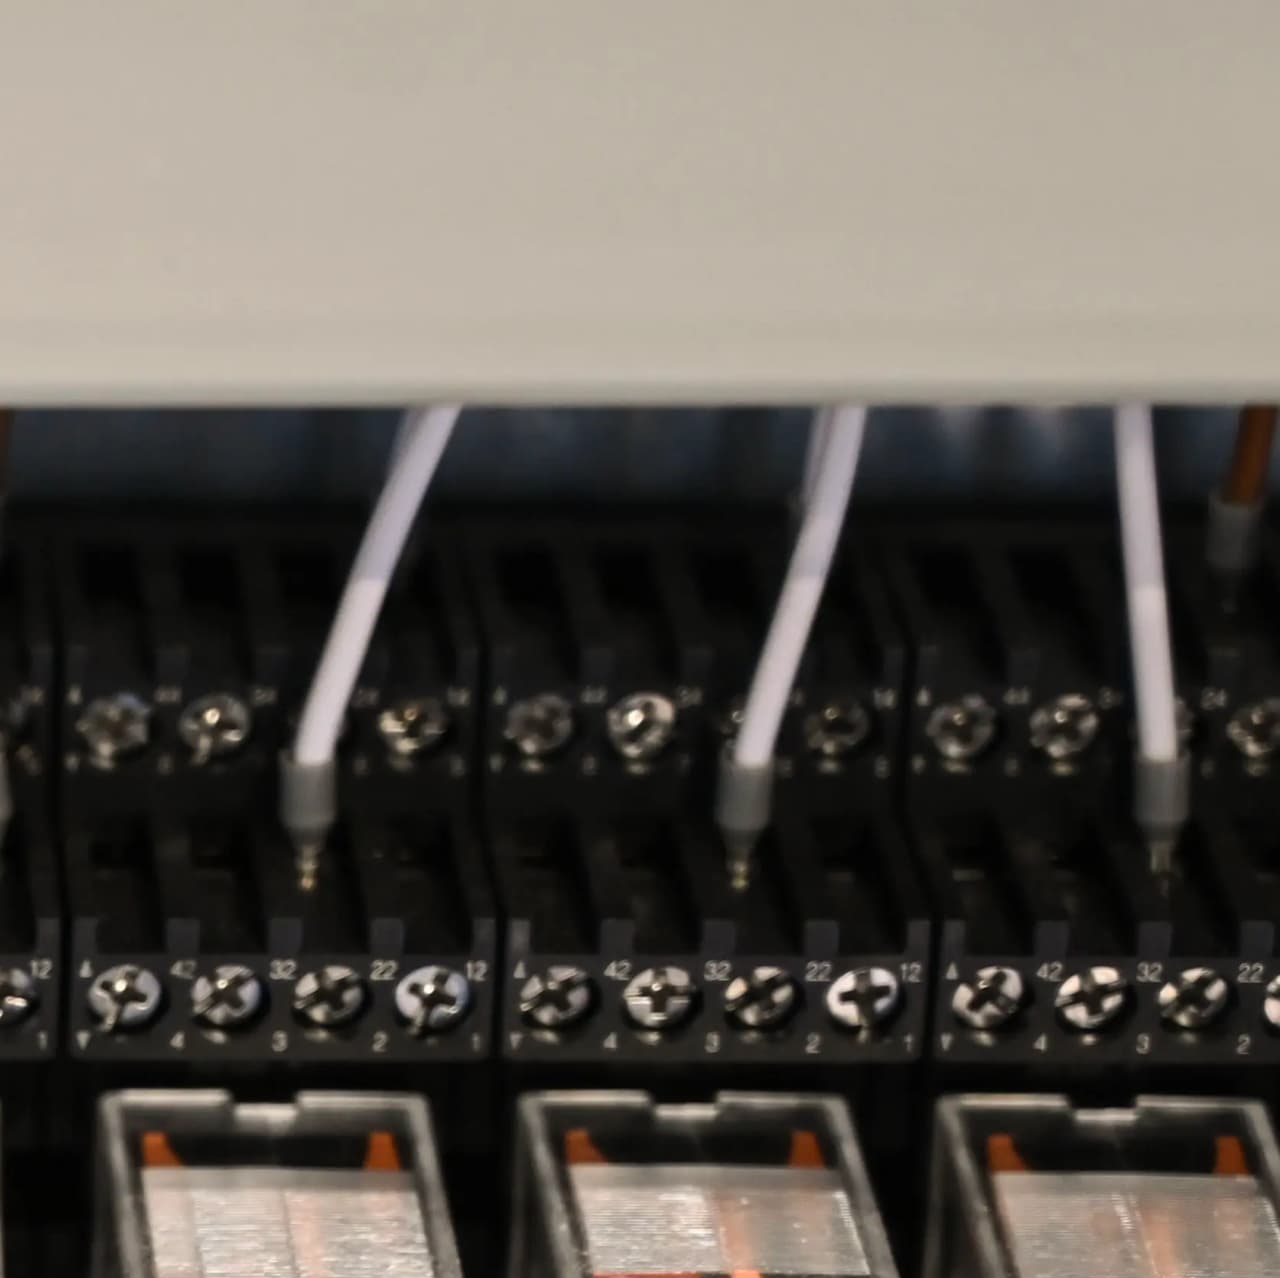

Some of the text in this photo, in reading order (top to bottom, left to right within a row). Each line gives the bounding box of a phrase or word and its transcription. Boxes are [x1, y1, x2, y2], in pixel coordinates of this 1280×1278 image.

[31, 960, 51, 979] 12
[171, 960, 487, 981] 42 32 22 12
[604, 960, 921, 982] 42 32 22 12
[1037, 962, 1264, 983] 42 32 22
[171, 1032, 184, 1048] 4
[272, 1031, 287, 1051] 3
[373, 1032, 387, 1051] 2
[604, 1033, 616, 1048] 4
[706, 1033, 719, 1053] 3
[805, 1034, 820, 1053] 2
[1035, 1034, 1250, 1054] 4 3 2
